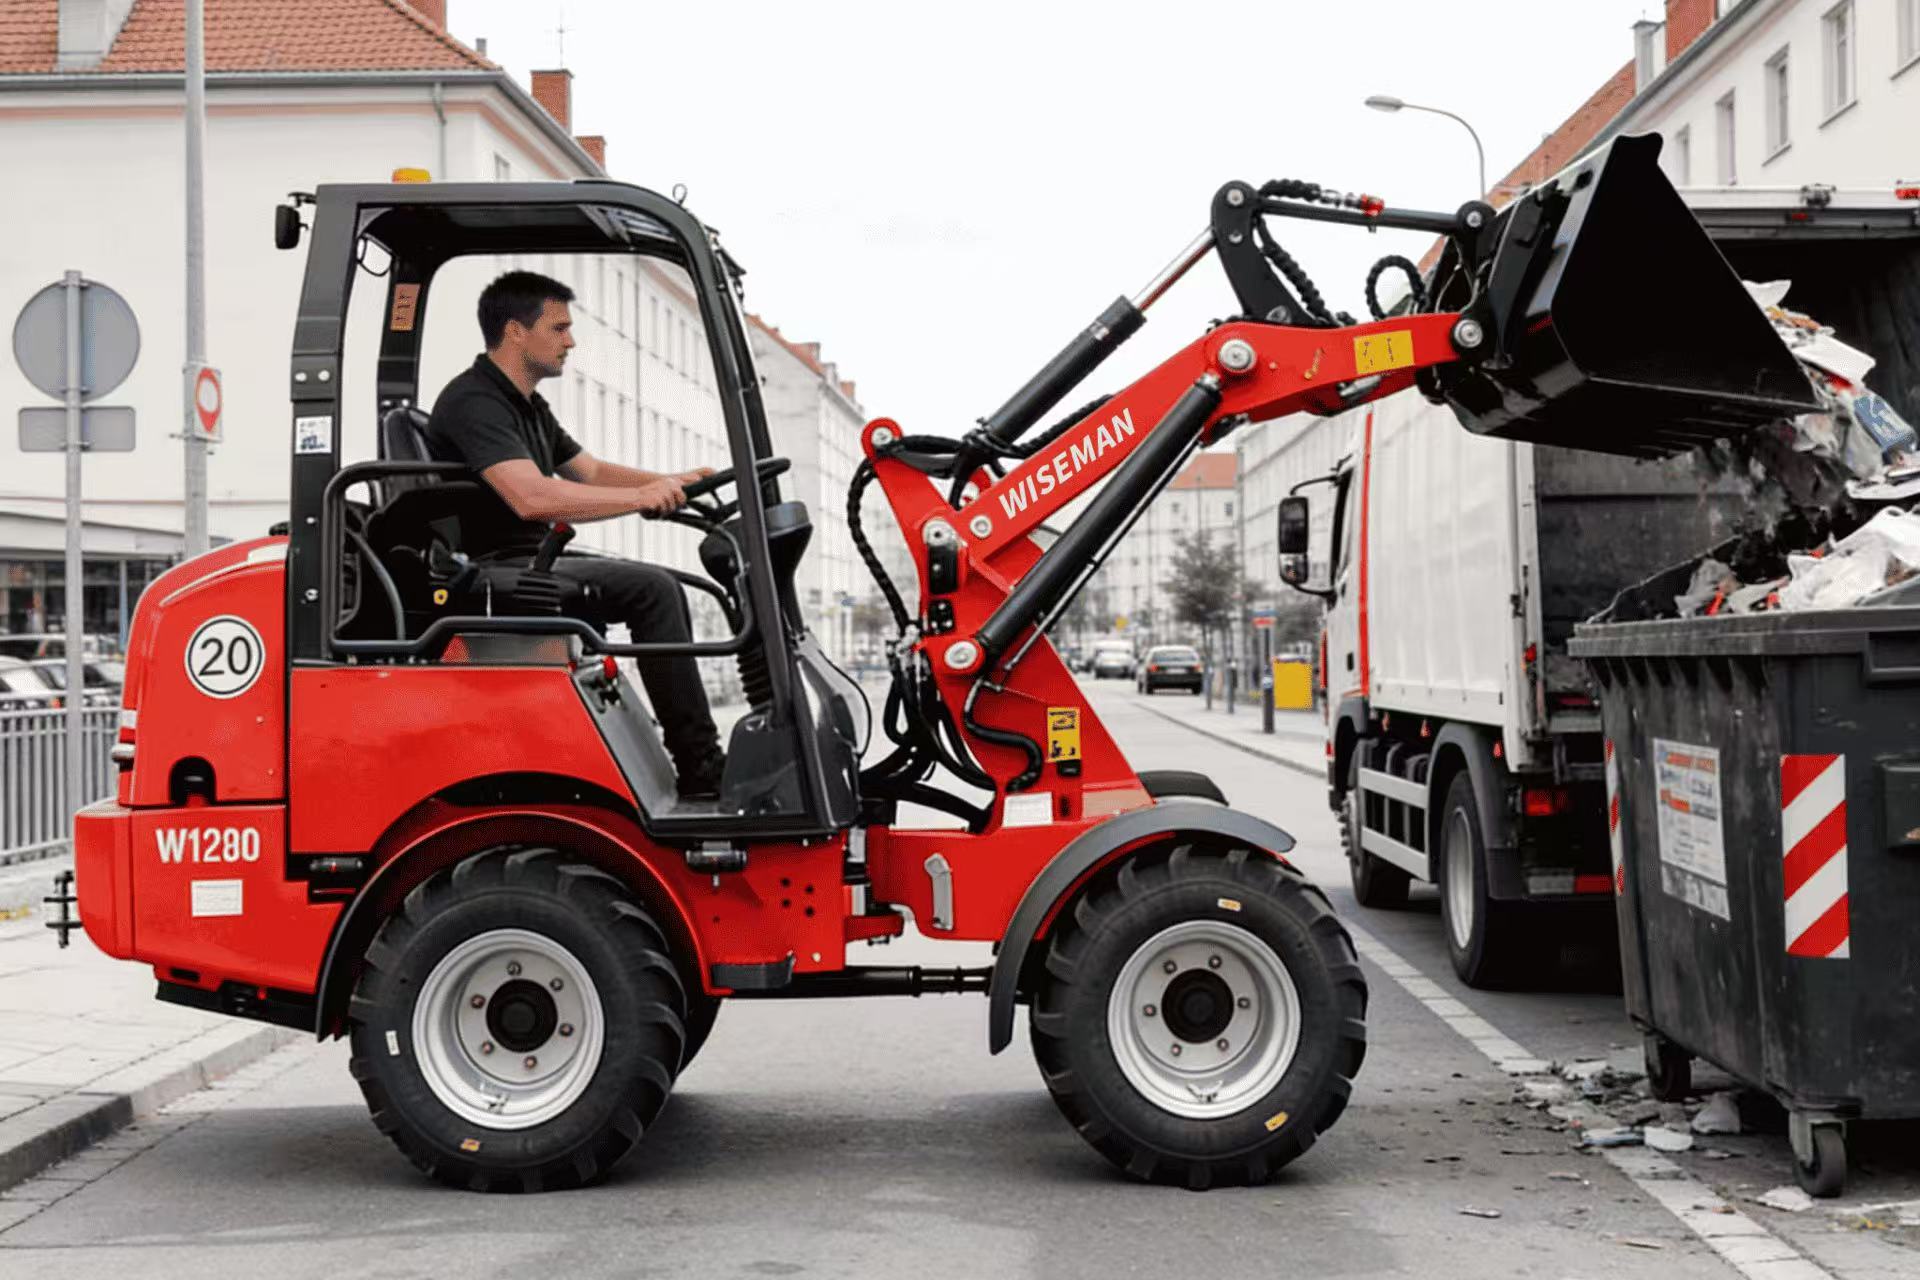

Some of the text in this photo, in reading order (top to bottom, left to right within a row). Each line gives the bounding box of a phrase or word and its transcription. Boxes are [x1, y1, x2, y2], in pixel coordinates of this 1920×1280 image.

[999, 408, 1136, 519] WISEMAN
[199, 637, 252, 676] 20
[155, 828, 260, 863] W1280
